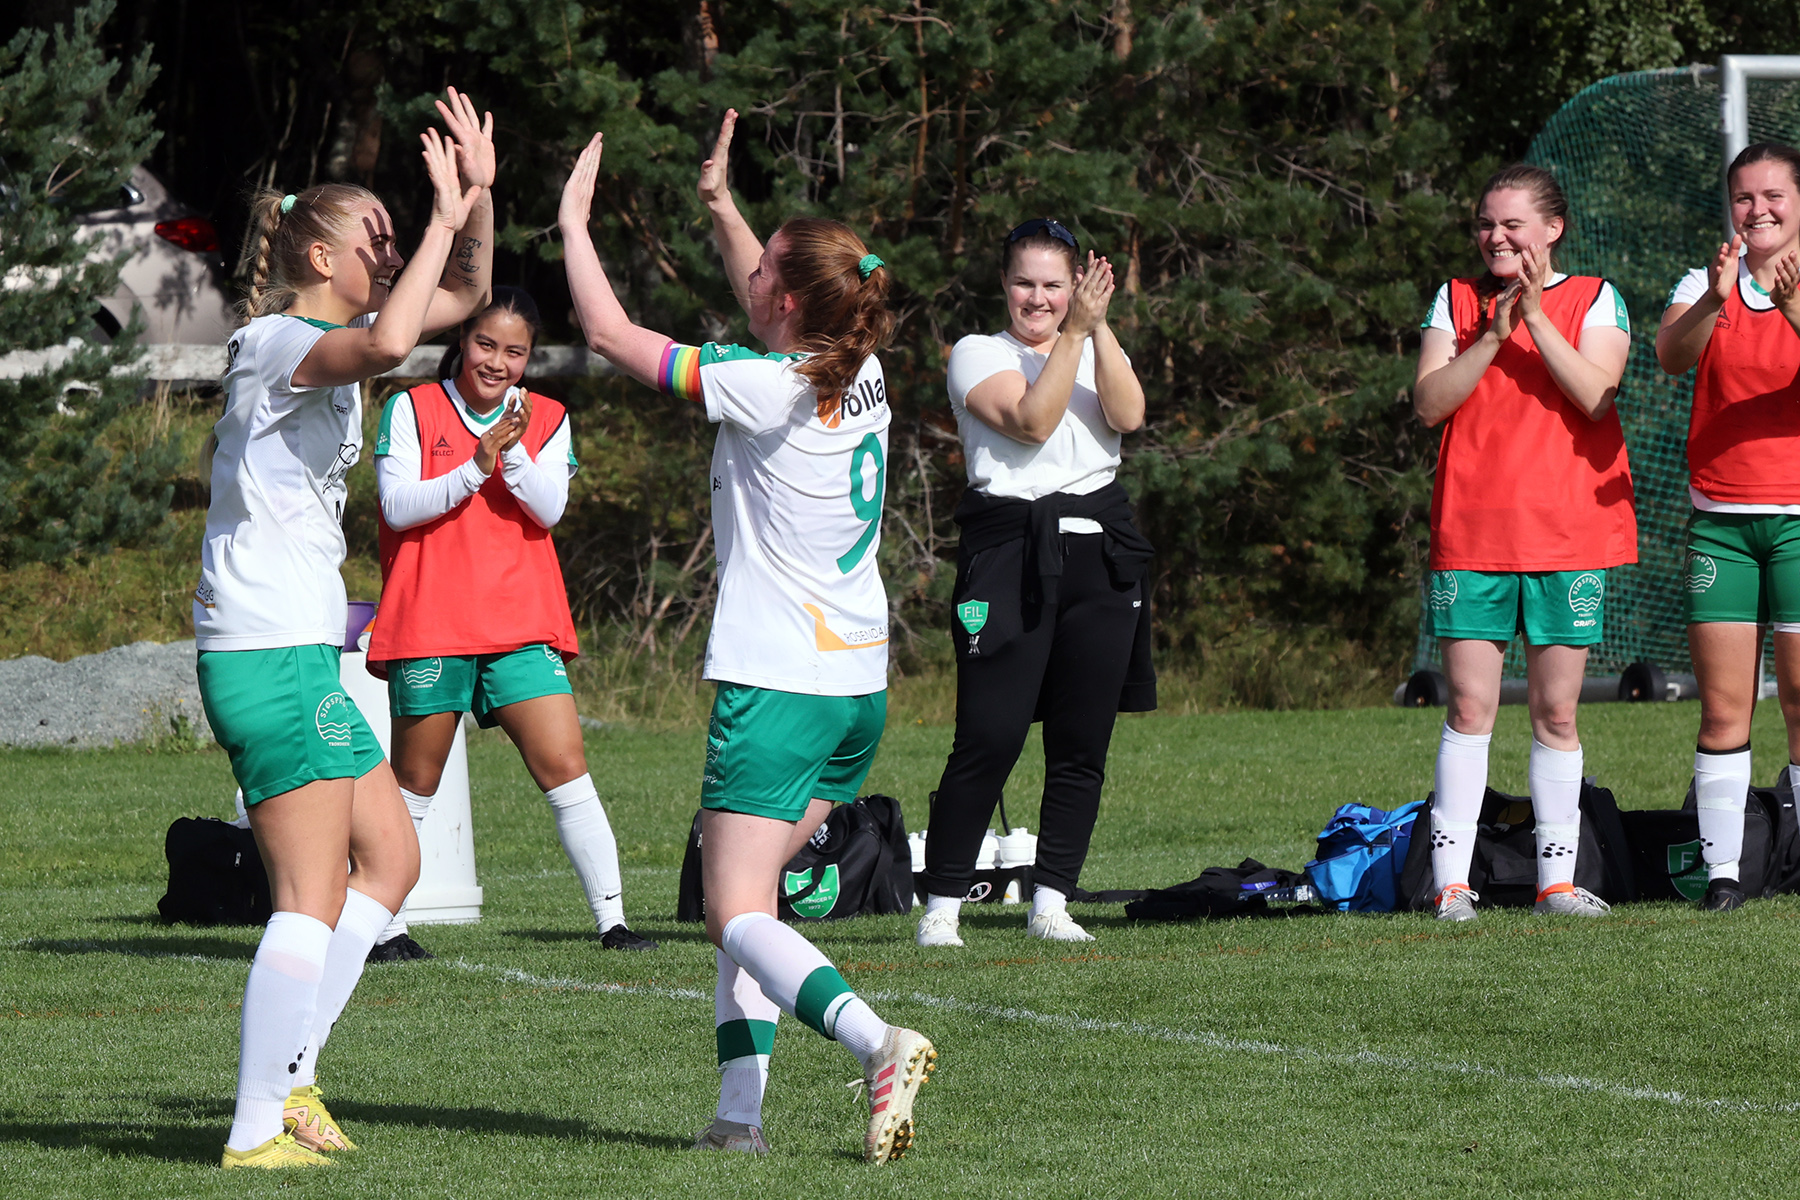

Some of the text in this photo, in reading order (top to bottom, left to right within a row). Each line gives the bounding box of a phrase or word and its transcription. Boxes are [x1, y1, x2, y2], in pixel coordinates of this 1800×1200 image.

[841, 378, 885, 420] folla
[836, 432, 884, 575] 9
[964, 606, 983, 618] FIL
